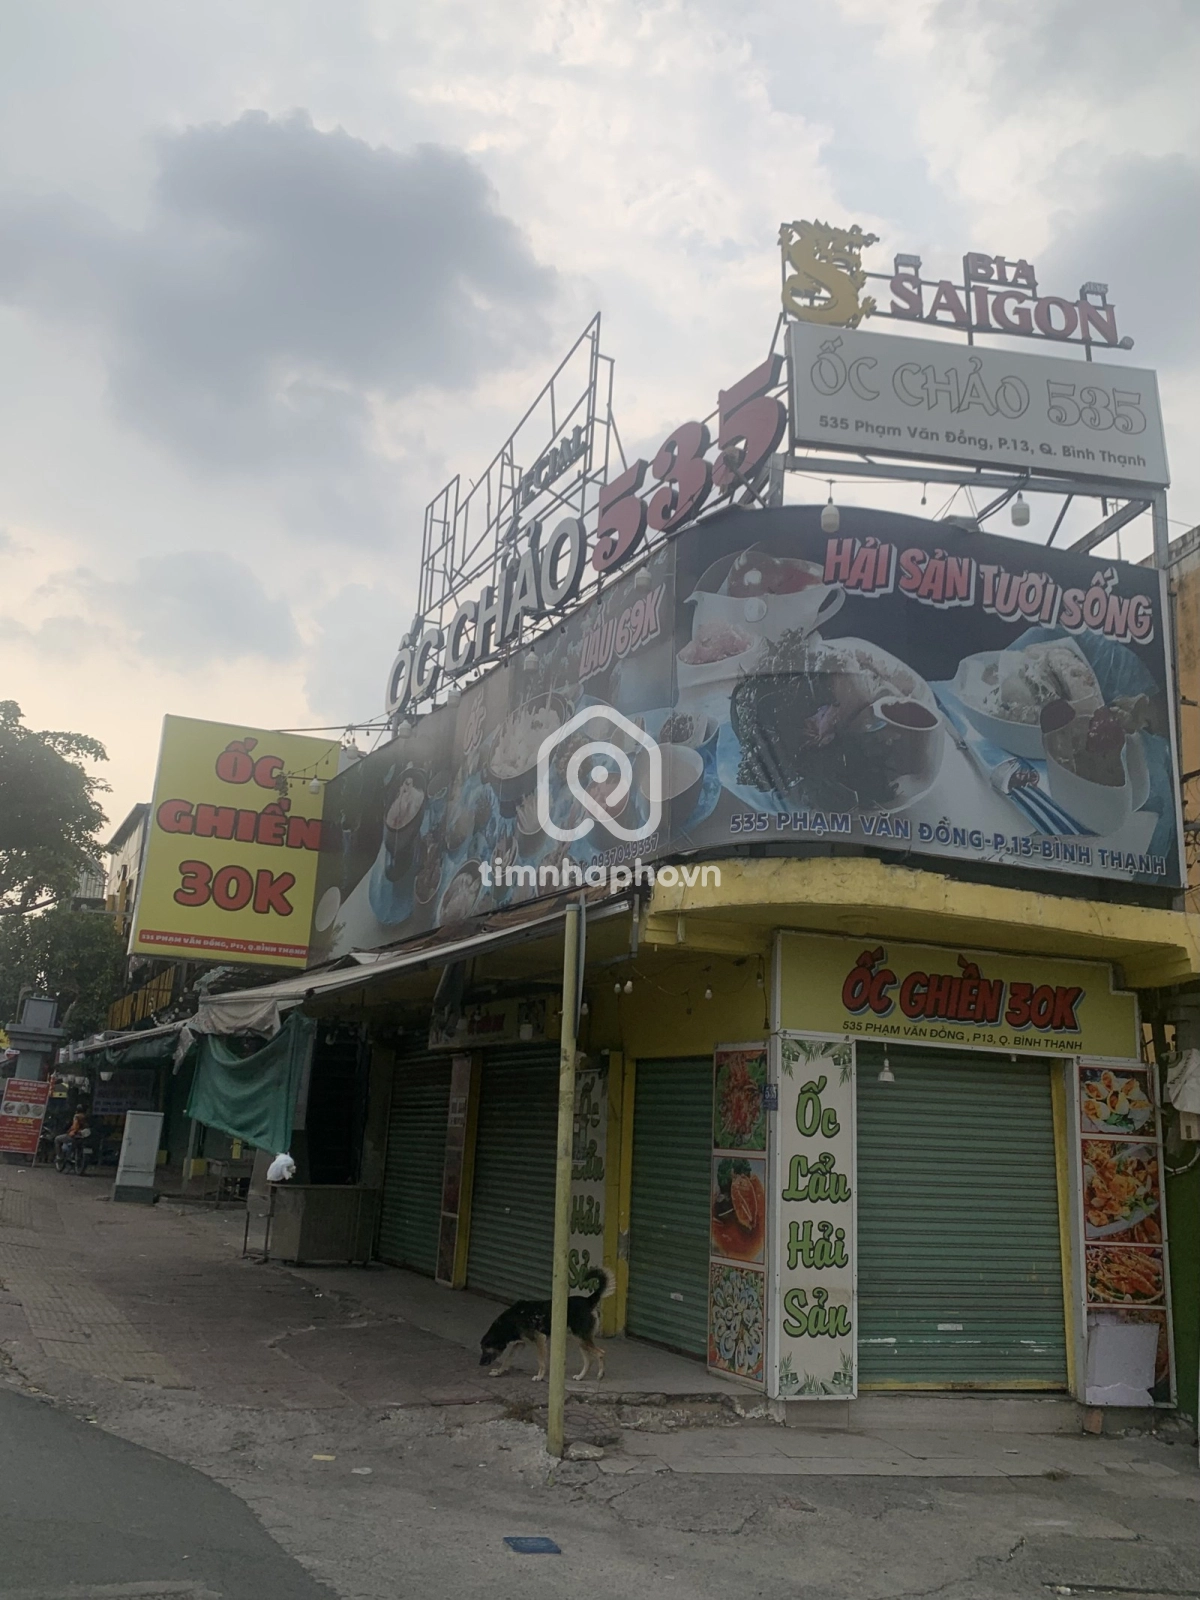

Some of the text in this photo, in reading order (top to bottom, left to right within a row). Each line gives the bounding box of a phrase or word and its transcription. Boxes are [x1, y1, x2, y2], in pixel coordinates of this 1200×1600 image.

[967, 252, 1038, 286] BIA
[890, 273, 1119, 346] SAIGON
[810, 336, 1147, 435] ỐC CHẢO 535
[819, 415, 1146, 468] 535 Phạm Văn Đồng, P.13, Q. Bình Thạnh
[385, 613, 445, 716] ỐC
[592, 353, 788, 573] 535
[822, 537, 1154, 645] HẢI SẢN TƯƠI SỐNG
[614, 582, 666, 659] 69K
[215, 737, 285, 789] ỐC
[730, 811, 769, 833] 535
[775, 811, 851, 836] PHẠM
[859, 812, 912, 840] VĂN
[1098, 848, 1167, 876] THẠNH
[174, 860, 296, 917] 30K
[842, 945, 1086, 1033] ỐC GHIỀN 30K
[842, 1020, 862, 1032] 535
[865, 1023, 901, 1037] PHẠM
[903, 1025, 928, 1038] VĂN
[972, 1032, 997, 1045] P13,
[999, 1034, 1011, 1047] Q.
[1013, 1034, 1041, 1048] BÌNH
[1044, 1039, 1083, 1051] THẠNH
[796, 1075, 840, 1138] Ốc
[782, 1152, 851, 1203] Lẩu
[570, 1194, 603, 1237] Hải
[787, 1220, 848, 1270] Hải
[783, 1287, 851, 1338] Sản
